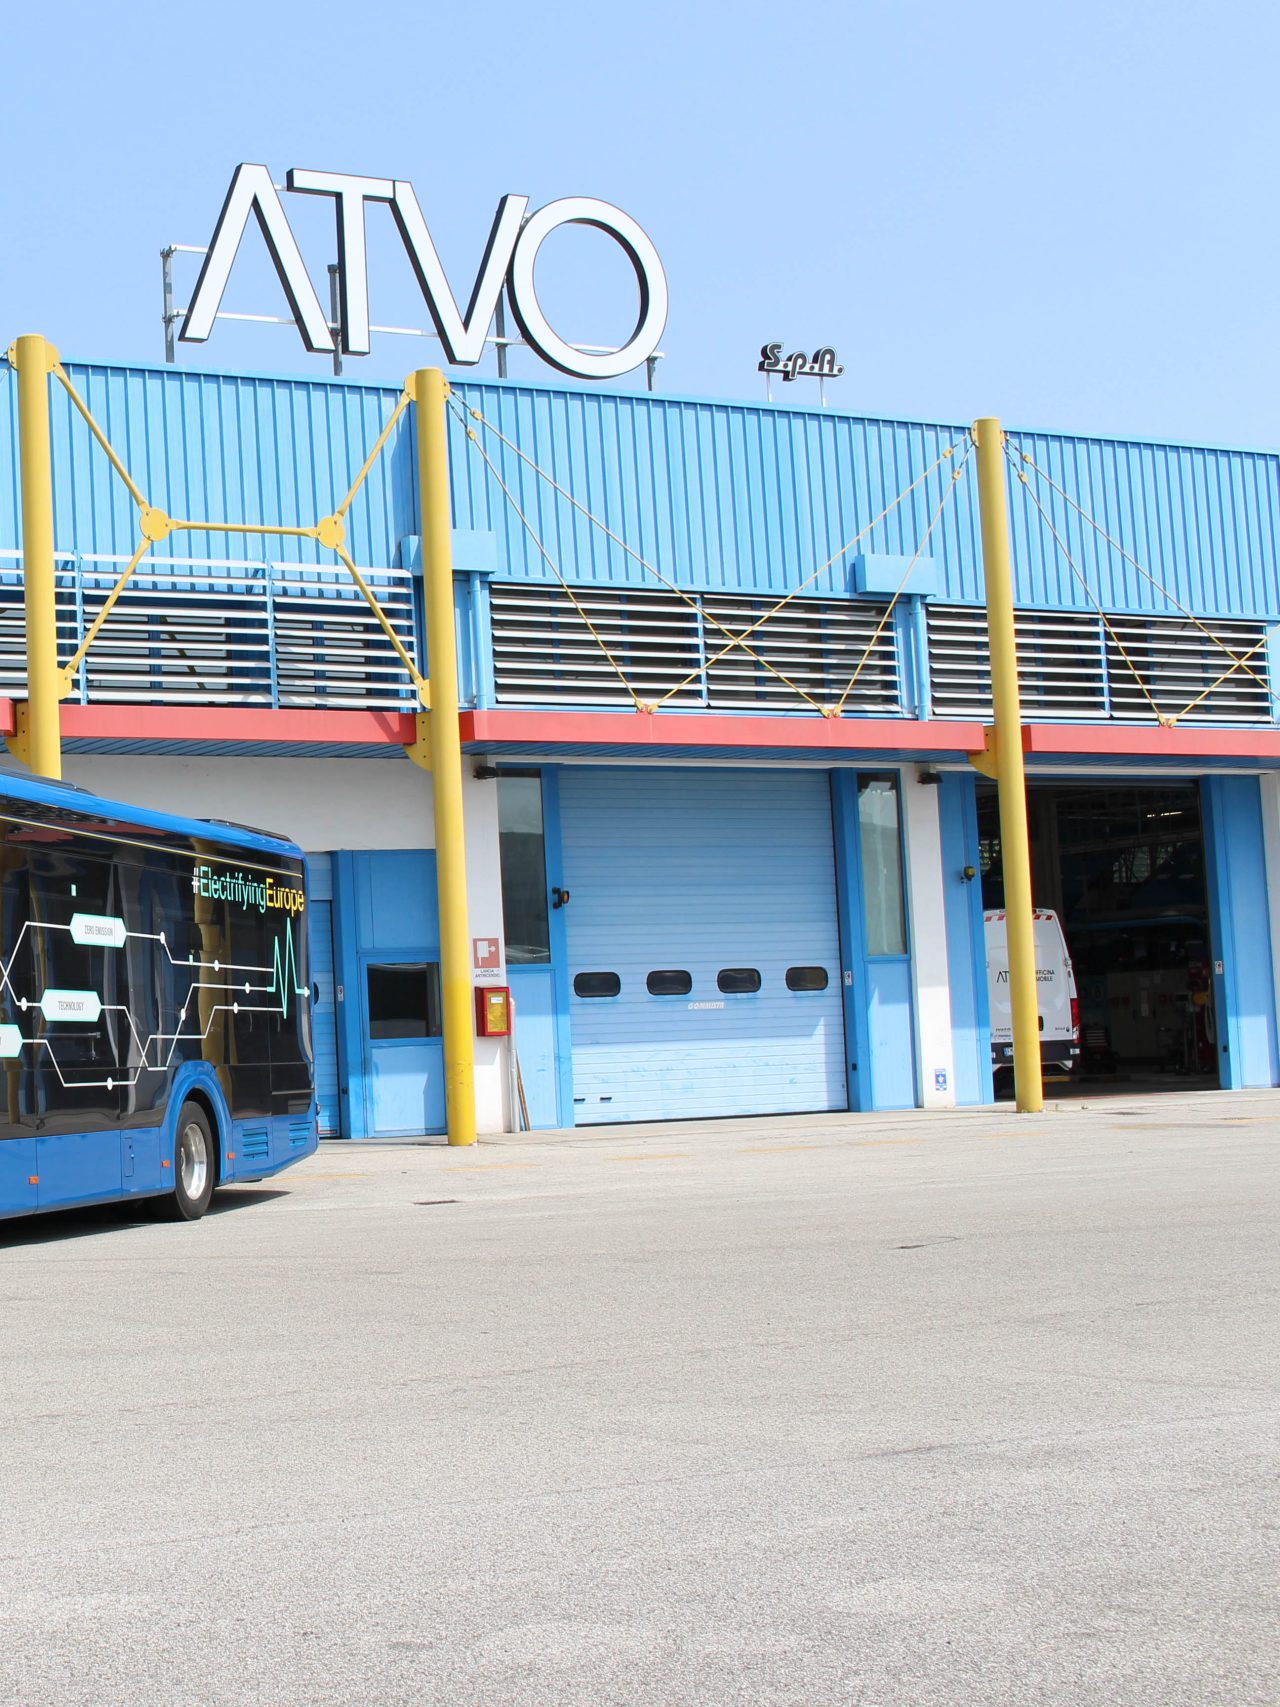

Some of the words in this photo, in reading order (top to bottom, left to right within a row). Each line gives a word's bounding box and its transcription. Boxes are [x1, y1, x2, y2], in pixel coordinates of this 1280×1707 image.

[178, 162, 669, 379] ATVO
[758, 342, 845, 381] S.p.A.
[191, 865, 305, 917] #ElectrifyingEurope
[58, 1000, 84, 1011] TECHNOLOGY
